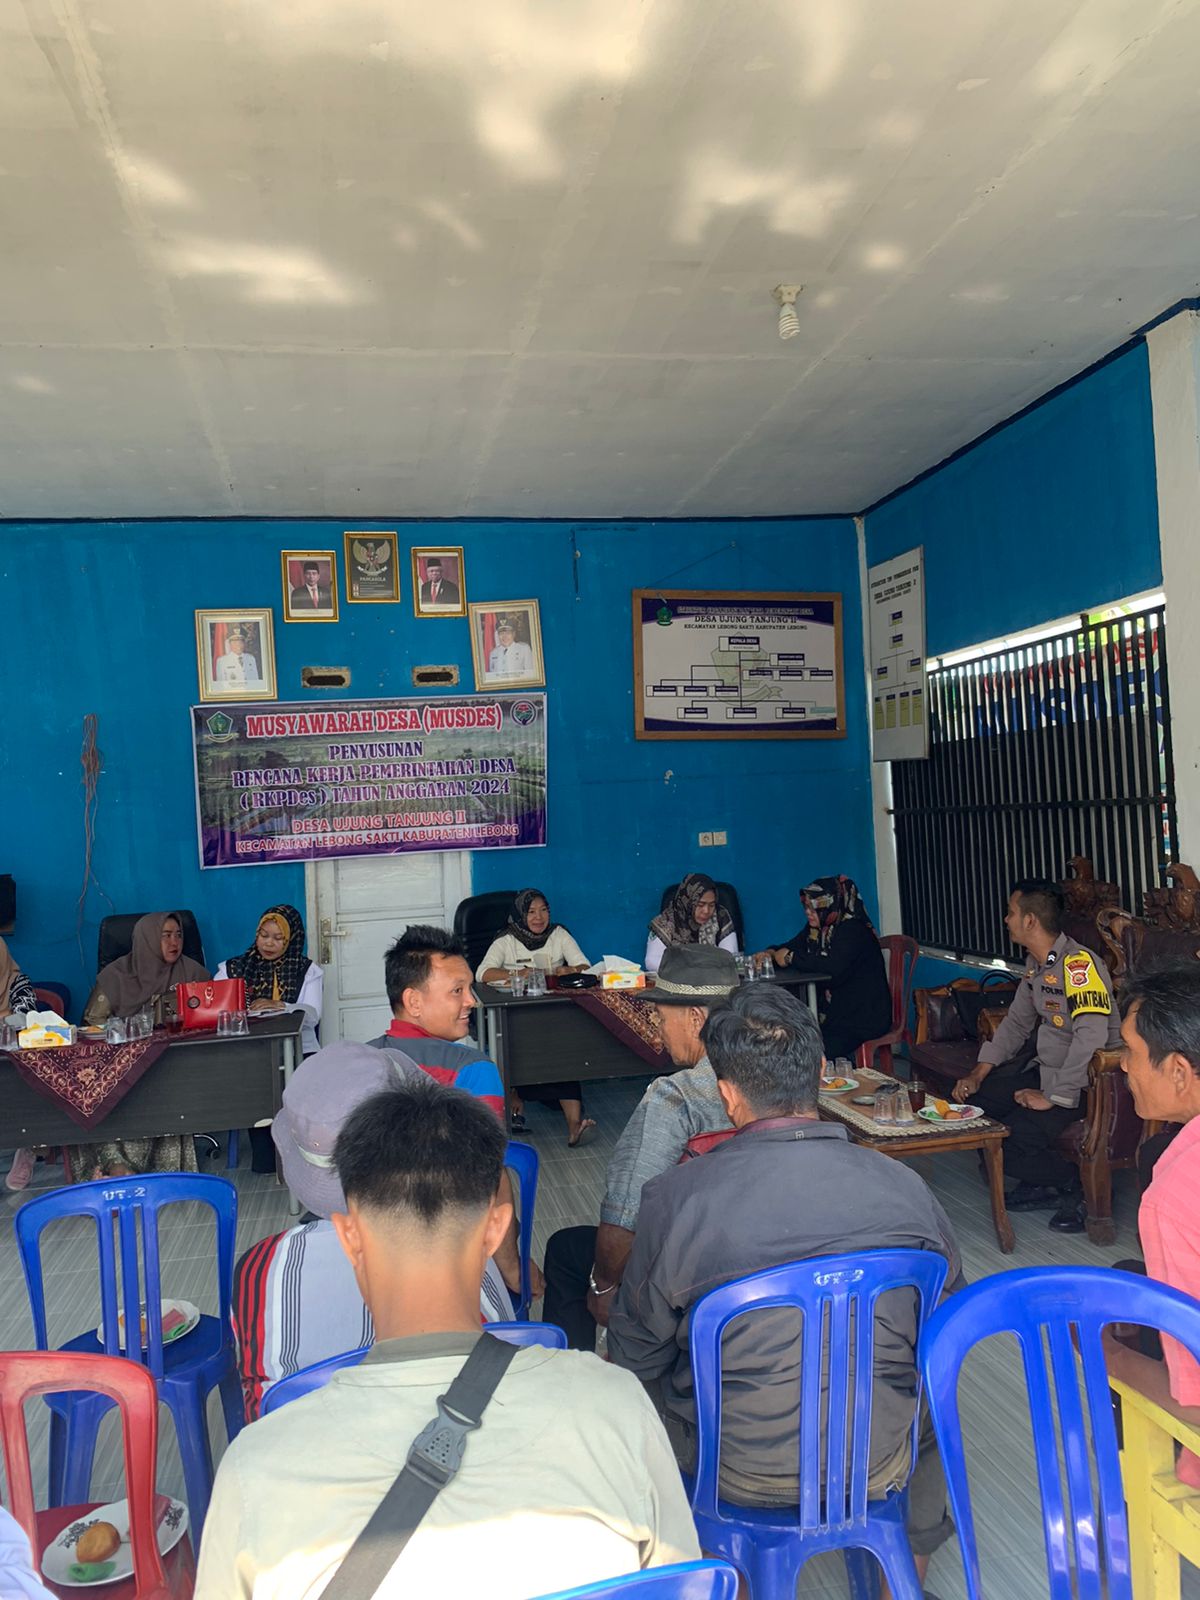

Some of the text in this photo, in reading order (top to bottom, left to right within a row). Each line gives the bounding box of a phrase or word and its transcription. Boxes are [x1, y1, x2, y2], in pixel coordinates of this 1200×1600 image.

[694, 615, 717, 623] DESA
[719, 615, 747, 623] UJUNG
[750, 615, 788, 624] TANJUNG
[246, 703, 502, 738] MUSYAWARAH DESA (MUSDES)
[328, 740, 424, 760] PENYUSUNAN
[232, 758, 516, 788] RENCANA KERJA PEMERINTAHAN DESA
[331, 785, 381, 803] TAHUN
[385, 780, 467, 800] ANGGARAN
[470, 778, 511, 795] 2024
[291, 809, 466, 833] DESA UJUNG TANJUNG II
[235, 824, 519, 853] KECAMATAN LEBONG SAKTI KABUPATEN LEBONG
